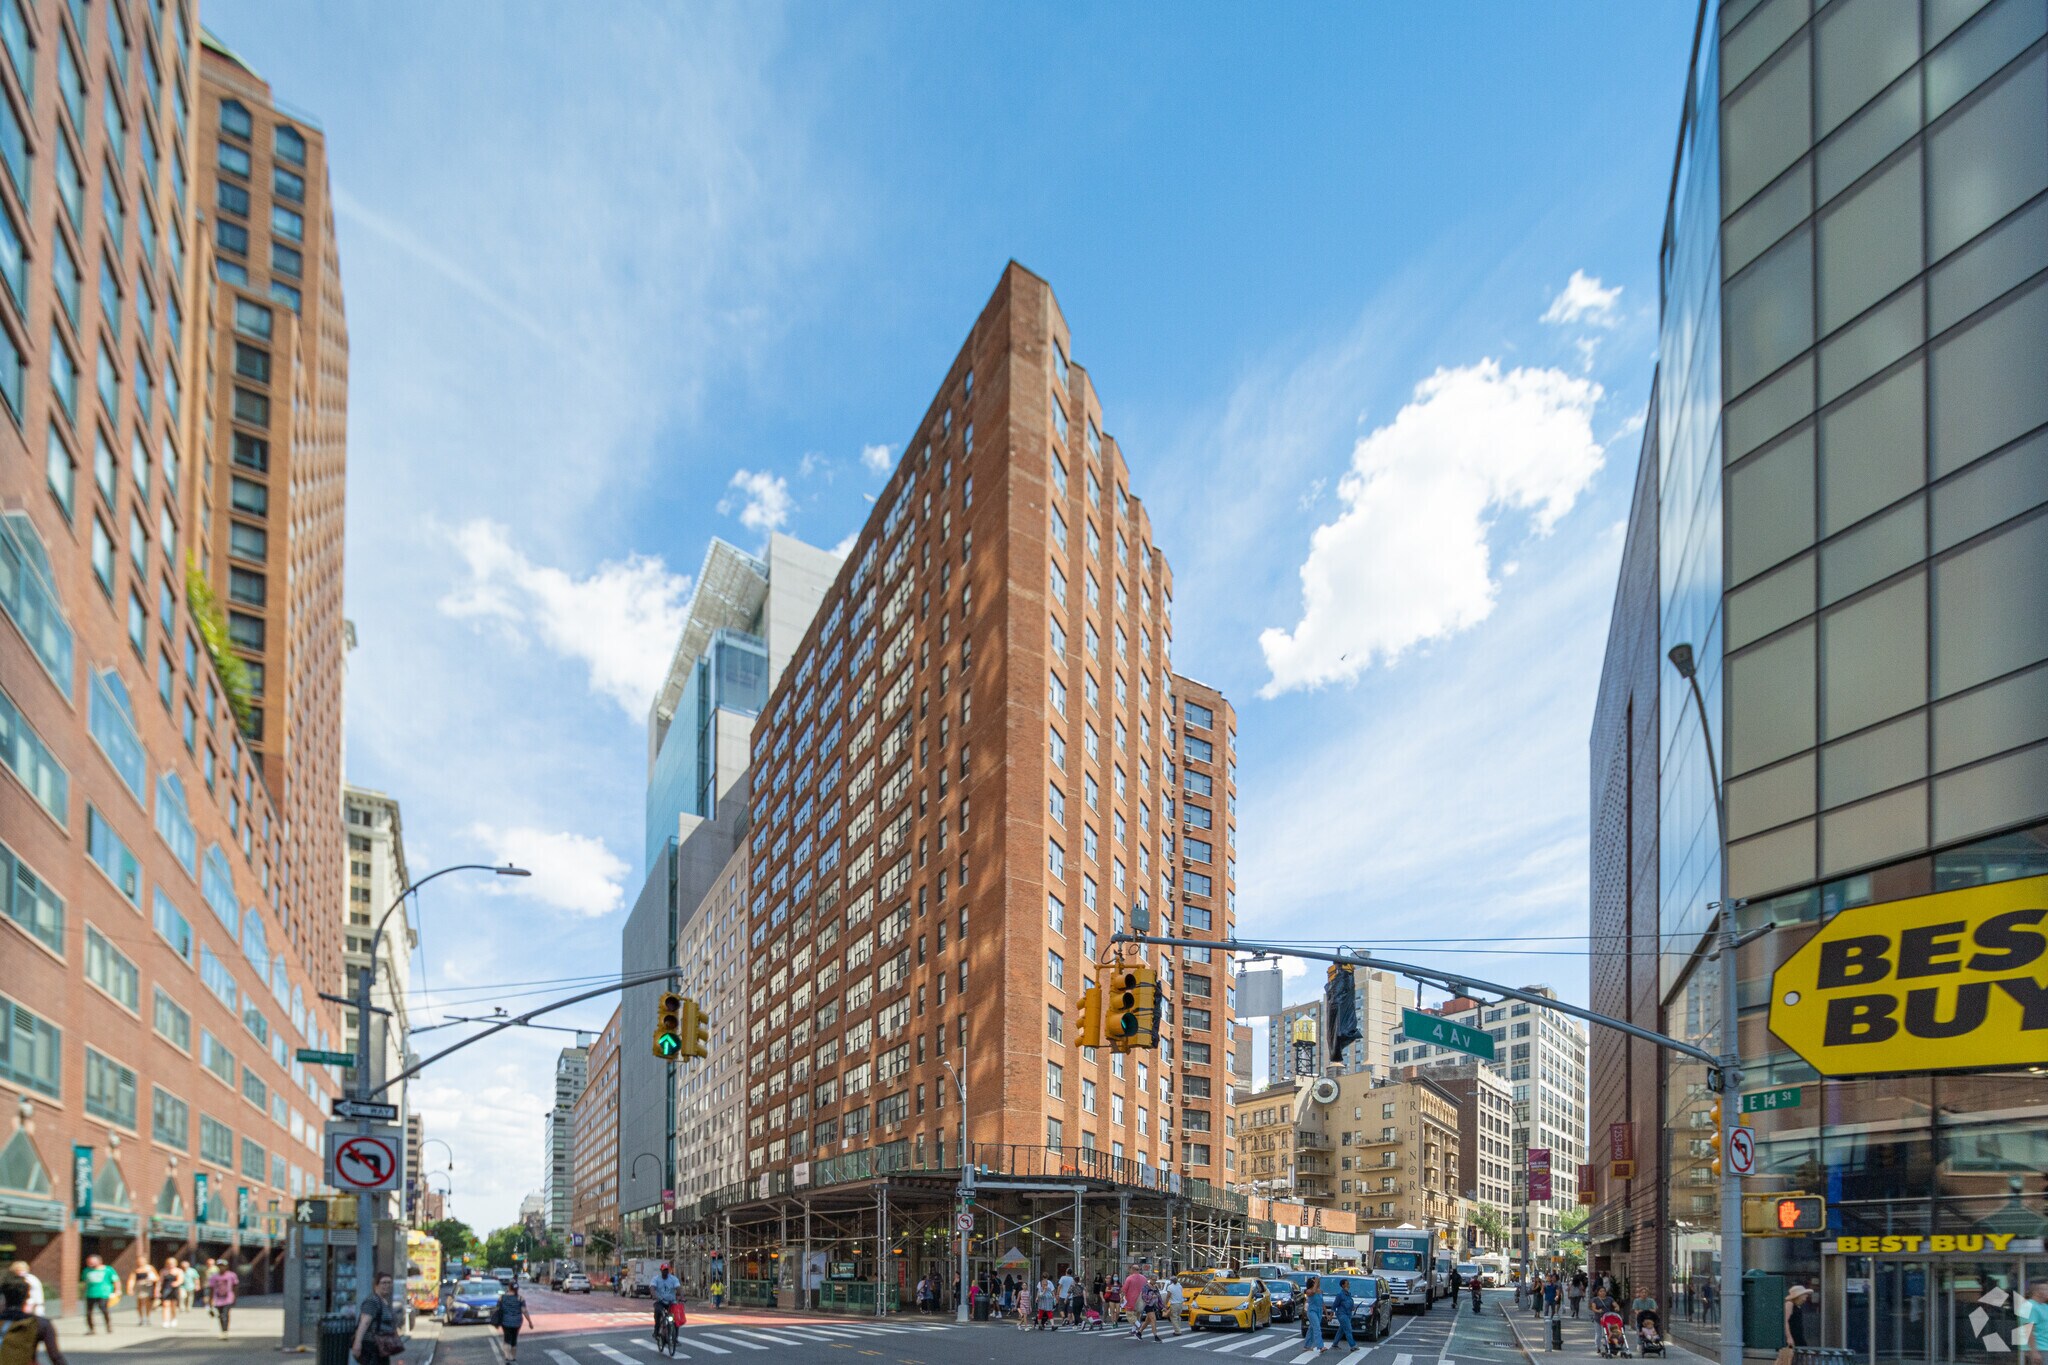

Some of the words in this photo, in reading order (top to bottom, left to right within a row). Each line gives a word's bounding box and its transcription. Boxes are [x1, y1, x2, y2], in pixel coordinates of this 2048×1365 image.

[1816, 908, 2048, 990] BES
[1432, 1023, 1444, 1041] 4
[1449, 1028, 1471, 1048] Av
[342, 1103, 361, 1112] ONE
[370, 1107, 392, 1115] WAY
[1408, 1085, 1417, 1141] TRUE
[1750, 1095, 1758, 1110] E
[1763, 1093, 1777, 1109] 14
[1782, 1091, 1792, 1101] St
[1408, 1150, 1417, 1221] NORTH
[1836, 1235, 1924, 1253] BEST
[1930, 1233, 2016, 1252] BUY
